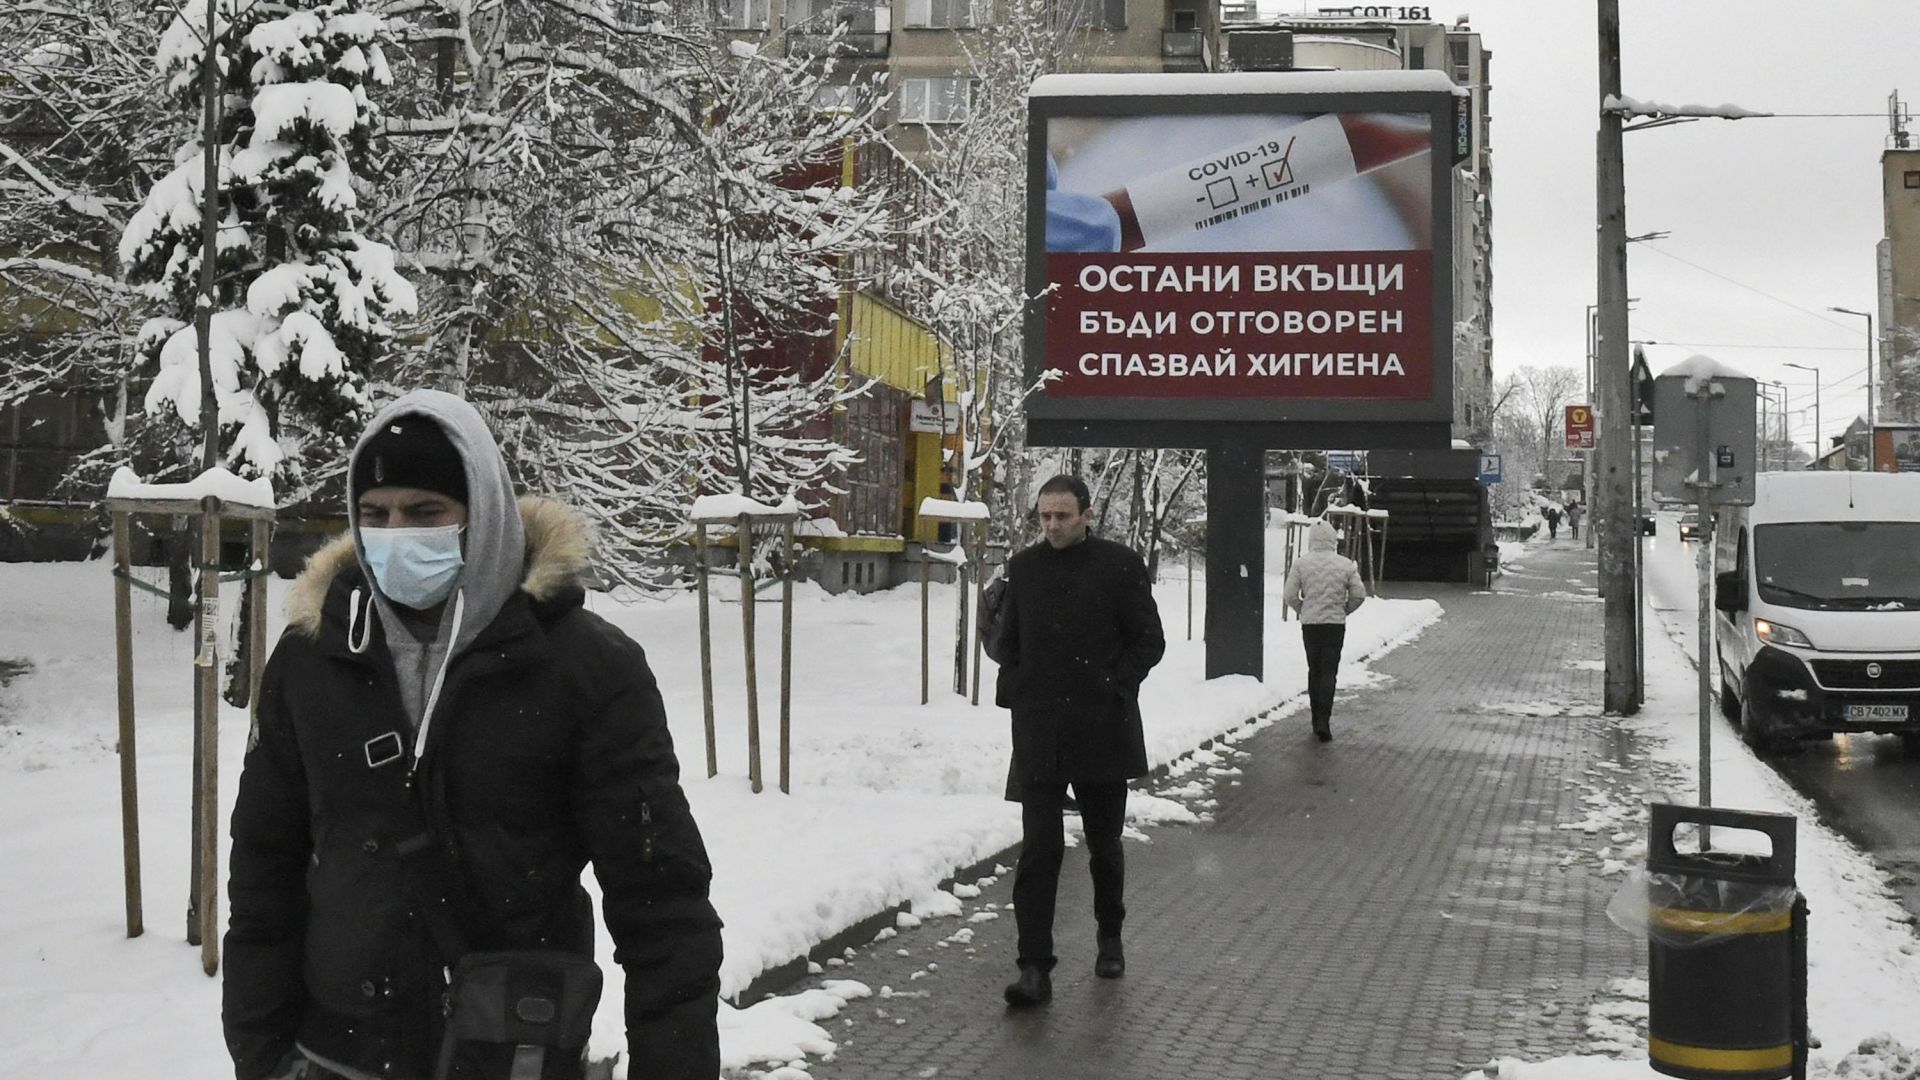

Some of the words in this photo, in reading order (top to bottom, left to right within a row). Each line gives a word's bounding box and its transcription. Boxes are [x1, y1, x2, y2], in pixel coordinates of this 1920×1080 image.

[1398, 6, 1431, 20] 161
[1188, 141, 1280, 181] COVID-19
[1079, 264, 1240, 292] ОСТАНИ
[1253, 263, 1404, 296] ВКЪЩИ
[1079, 311, 1177, 338] БЪДИ
[1190, 310, 1403, 334] ОТГОВОРЕН
[1078, 347, 1236, 376] СПАЗВАЙ
[1246, 352, 1405, 377] ХИГИЕНА
